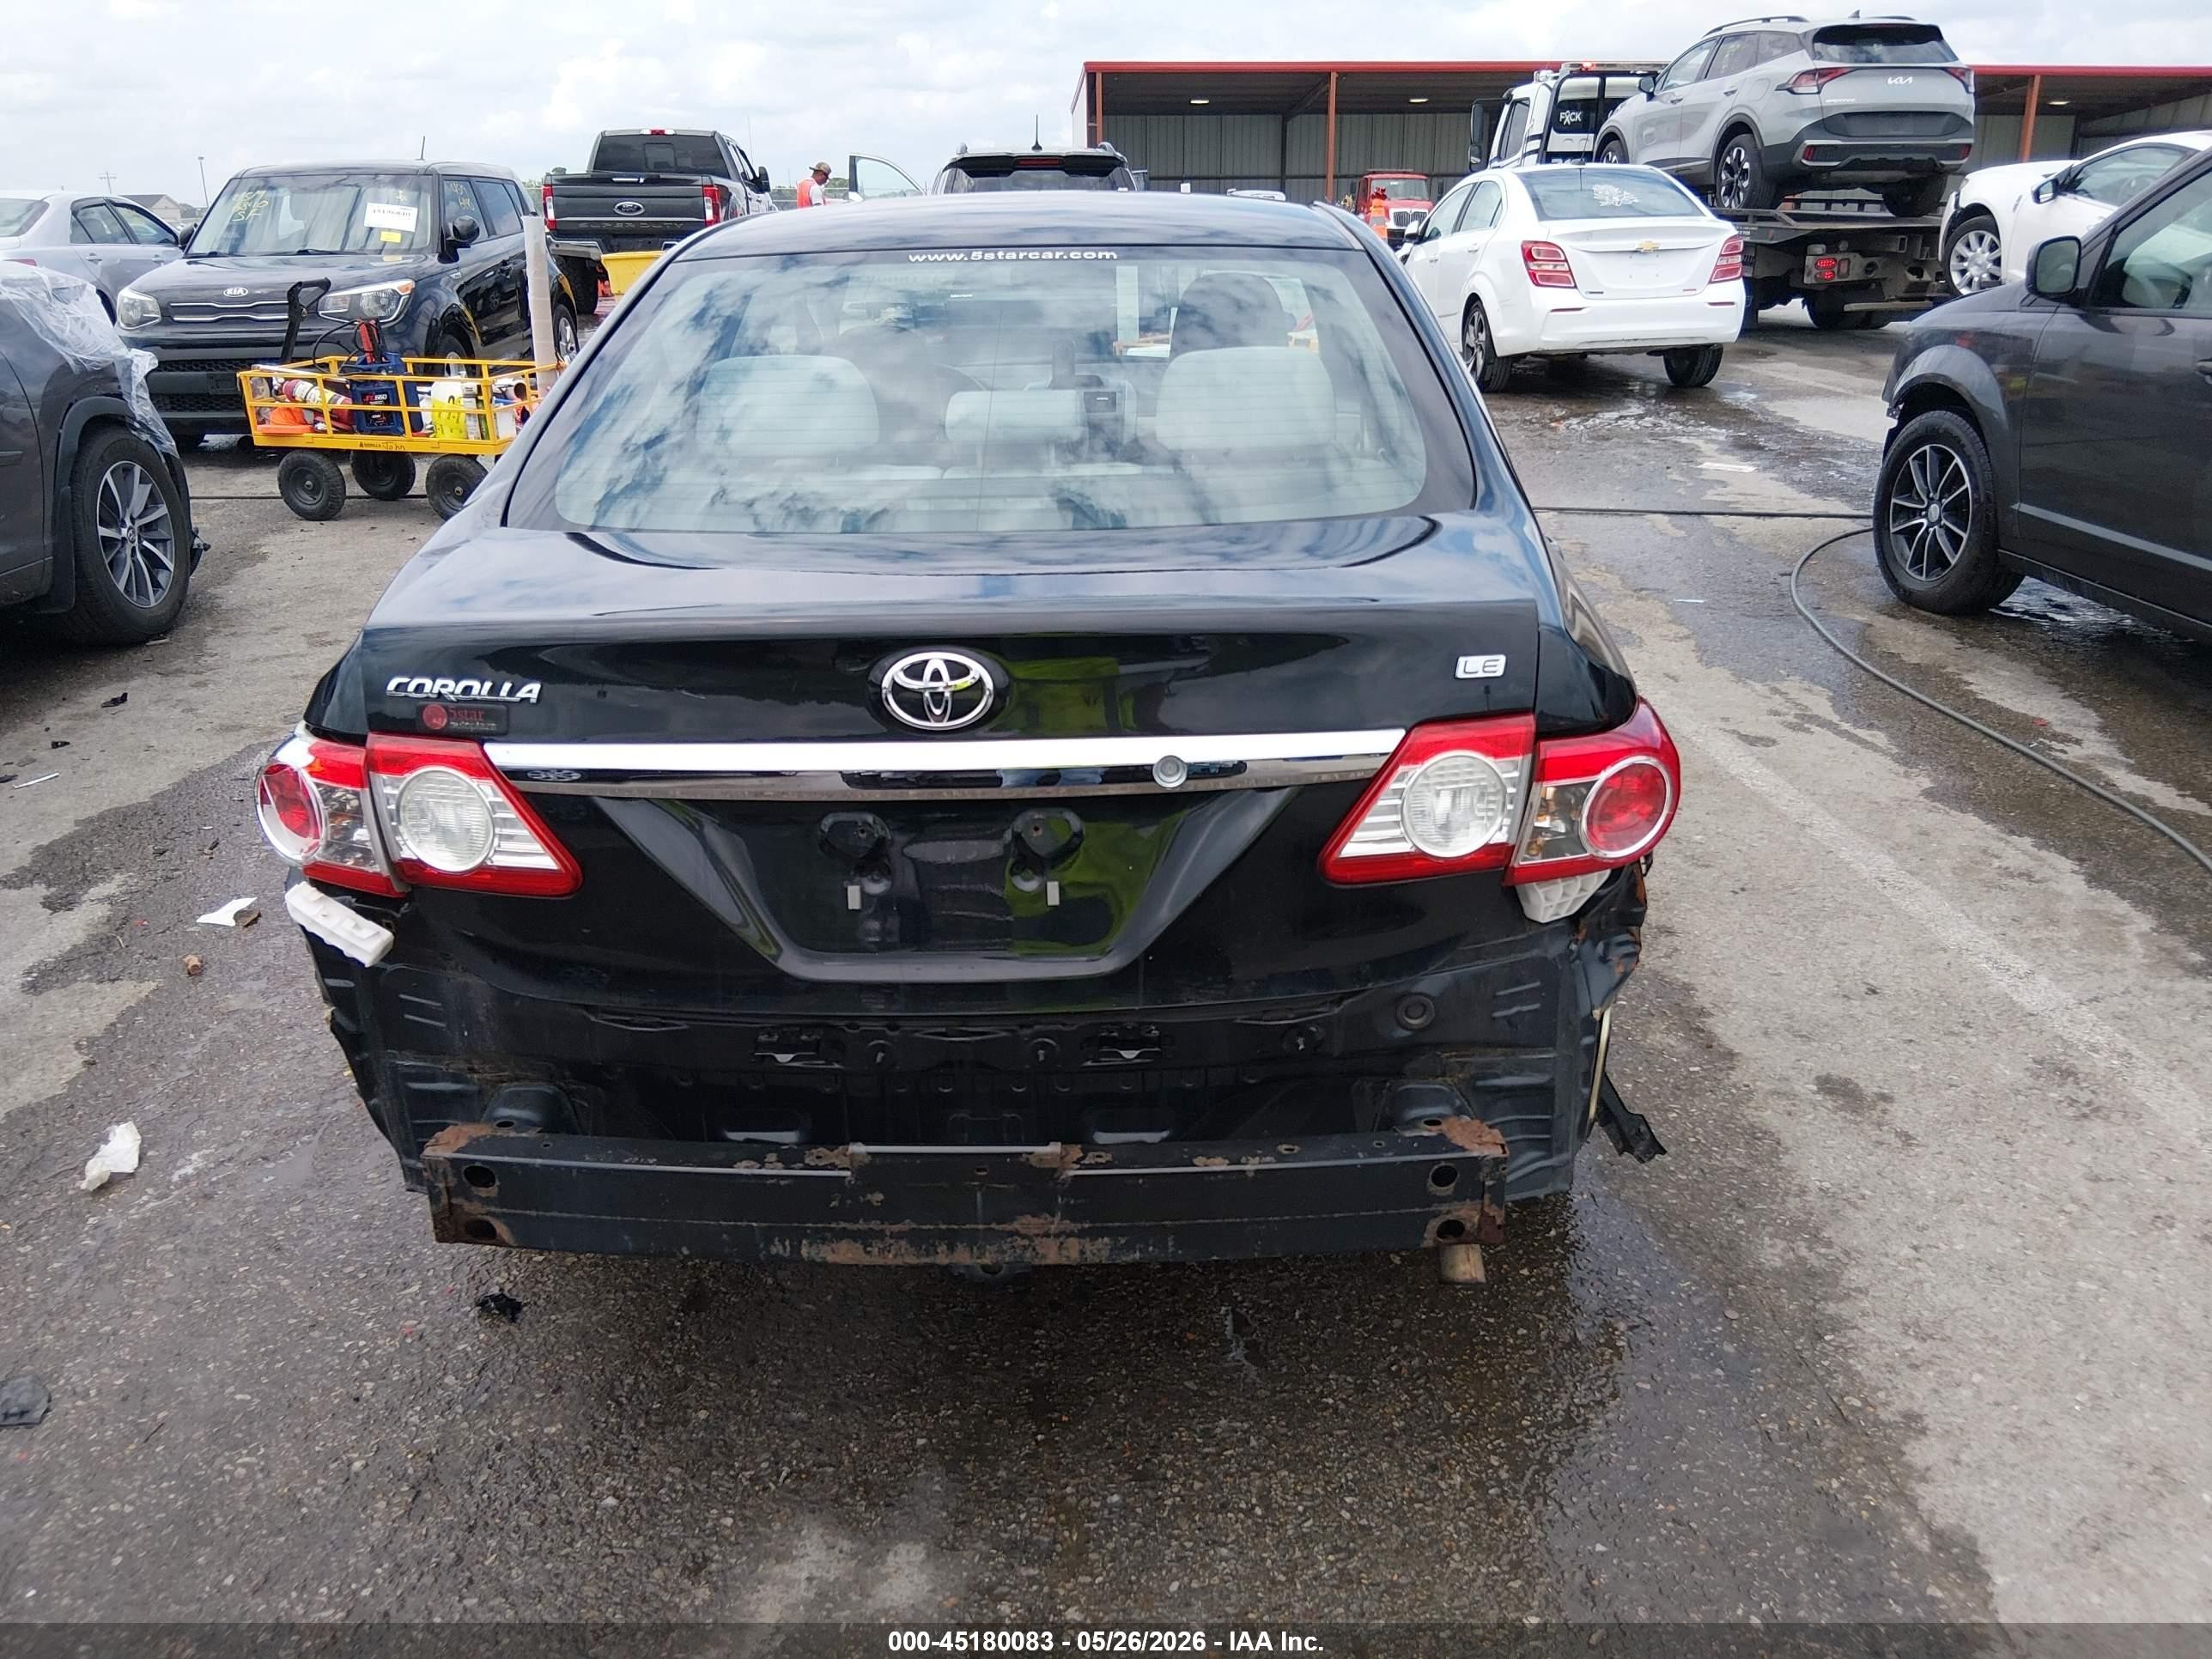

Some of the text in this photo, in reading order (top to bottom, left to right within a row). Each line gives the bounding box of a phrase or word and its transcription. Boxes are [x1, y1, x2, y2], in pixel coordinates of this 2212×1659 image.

[1559, 110, 1582, 125] FCK
[908, 250, 1118, 263] www.5starcar.com
[1462, 658, 1501, 675] LE
[386, 678, 542, 703] COROLLA
